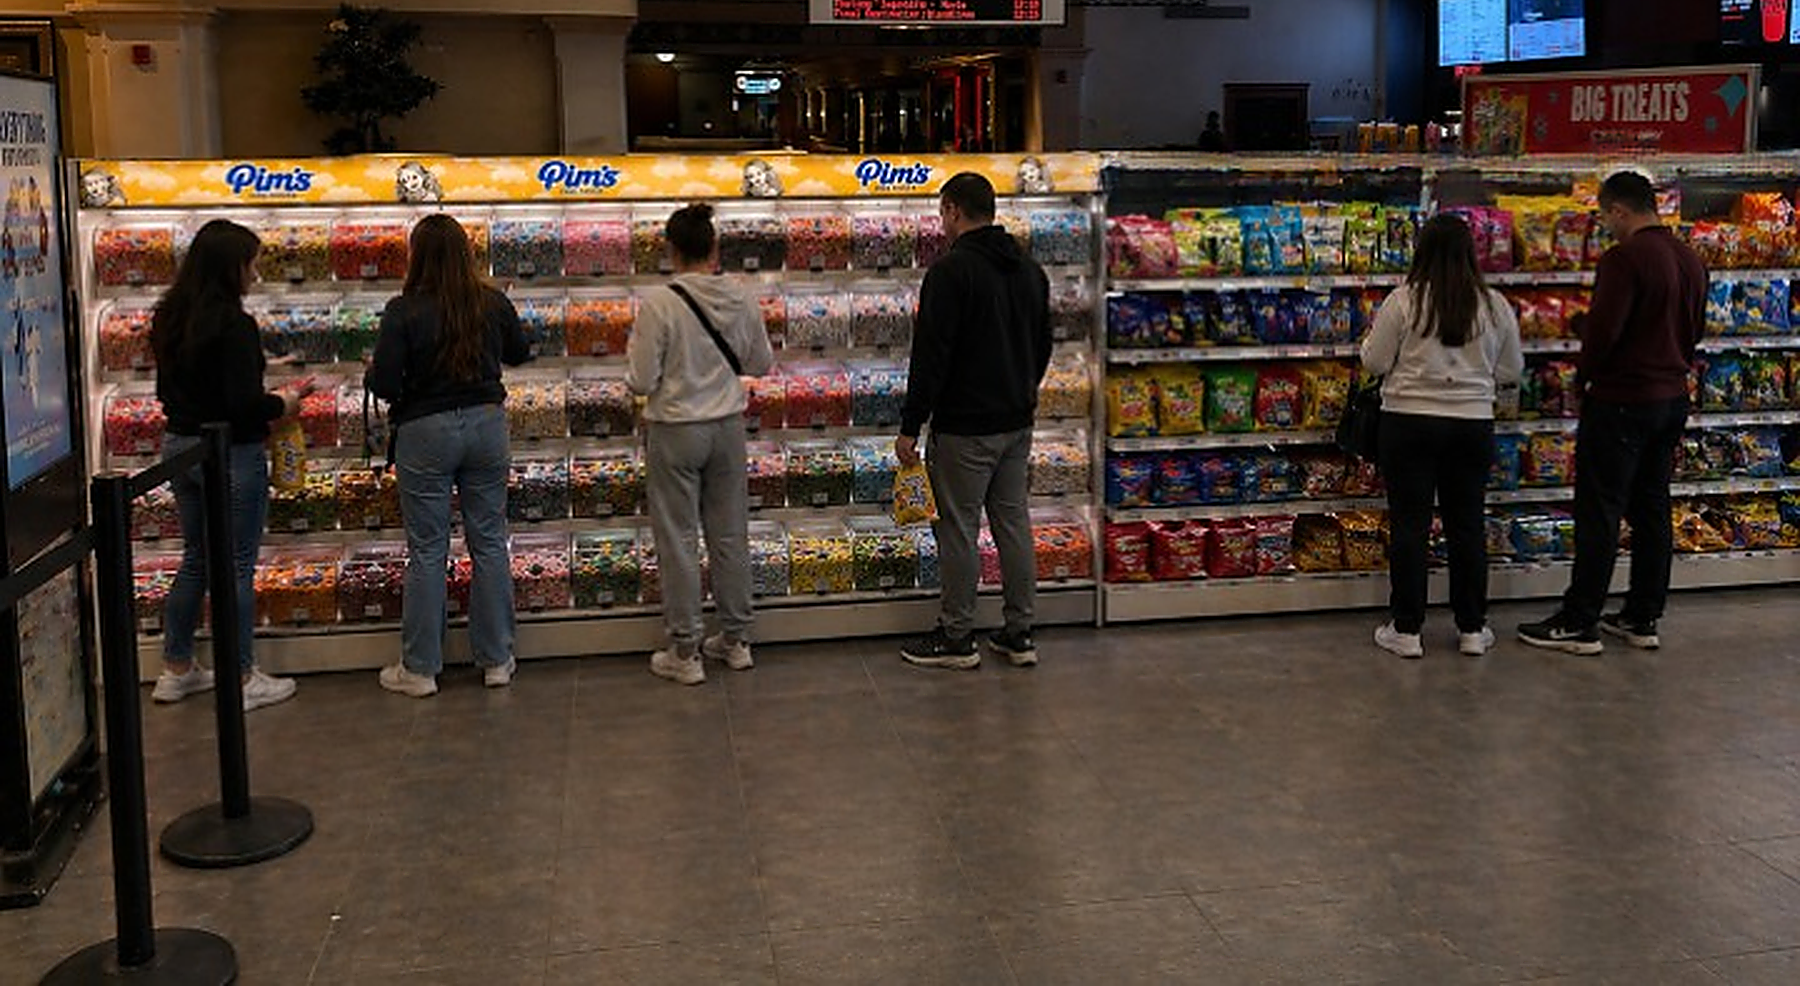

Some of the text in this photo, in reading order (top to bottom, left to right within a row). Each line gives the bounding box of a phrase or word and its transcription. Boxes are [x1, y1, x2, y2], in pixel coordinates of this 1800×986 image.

[1571, 82, 1690, 122] BIG TREATS
[225, 164, 315, 194] Pim's
[538, 160, 621, 191] Pim's
[856, 158, 932, 186] Pim's
